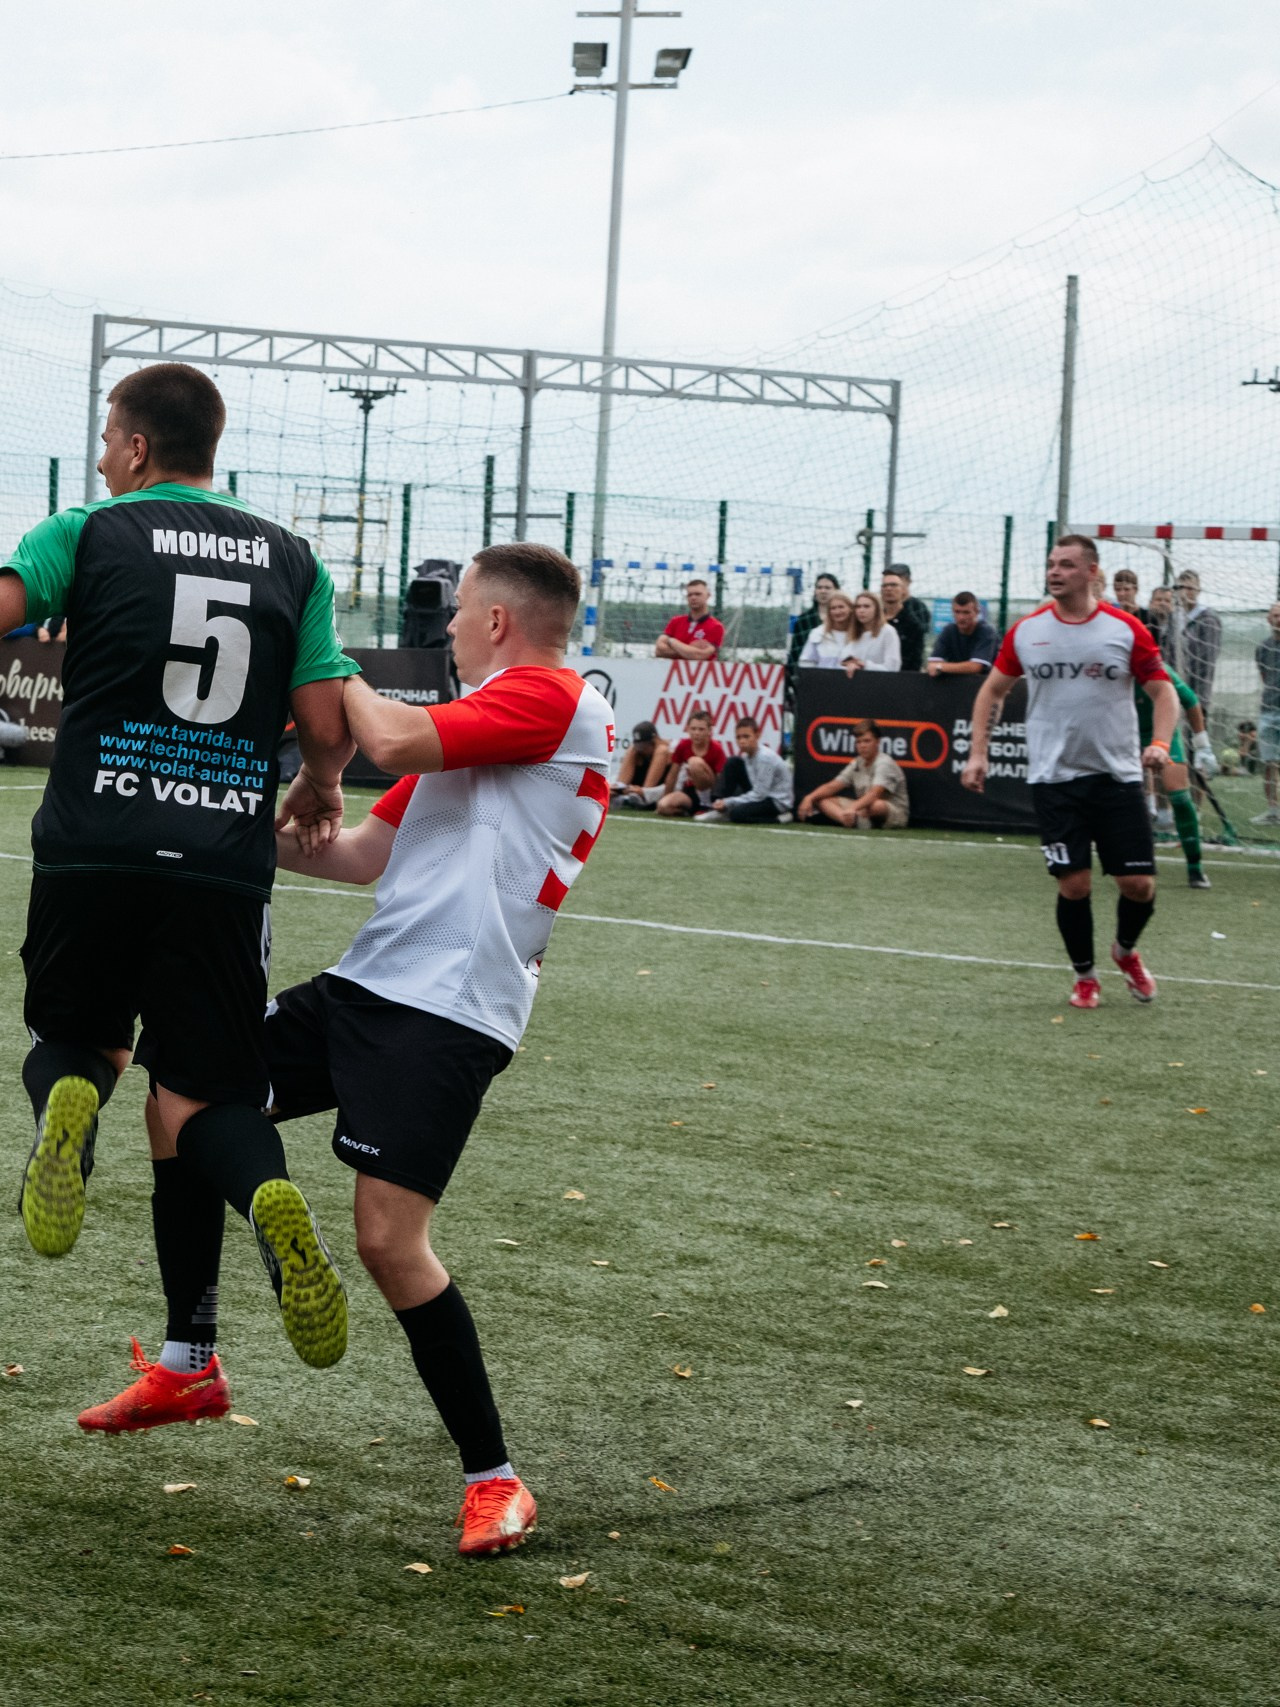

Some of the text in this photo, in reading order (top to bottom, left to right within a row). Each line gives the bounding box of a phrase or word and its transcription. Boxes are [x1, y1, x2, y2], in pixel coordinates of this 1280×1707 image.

[152, 528, 270, 569] МОИСЕЙ
[161, 573, 252, 725] 5
[99, 734, 268, 773] www.technoavia.ru
[122, 719, 254, 753] www.tavrida.ru
[99, 752, 264, 789] www.volat-auto.ru
[93, 769, 264, 816] FC VOLAT
